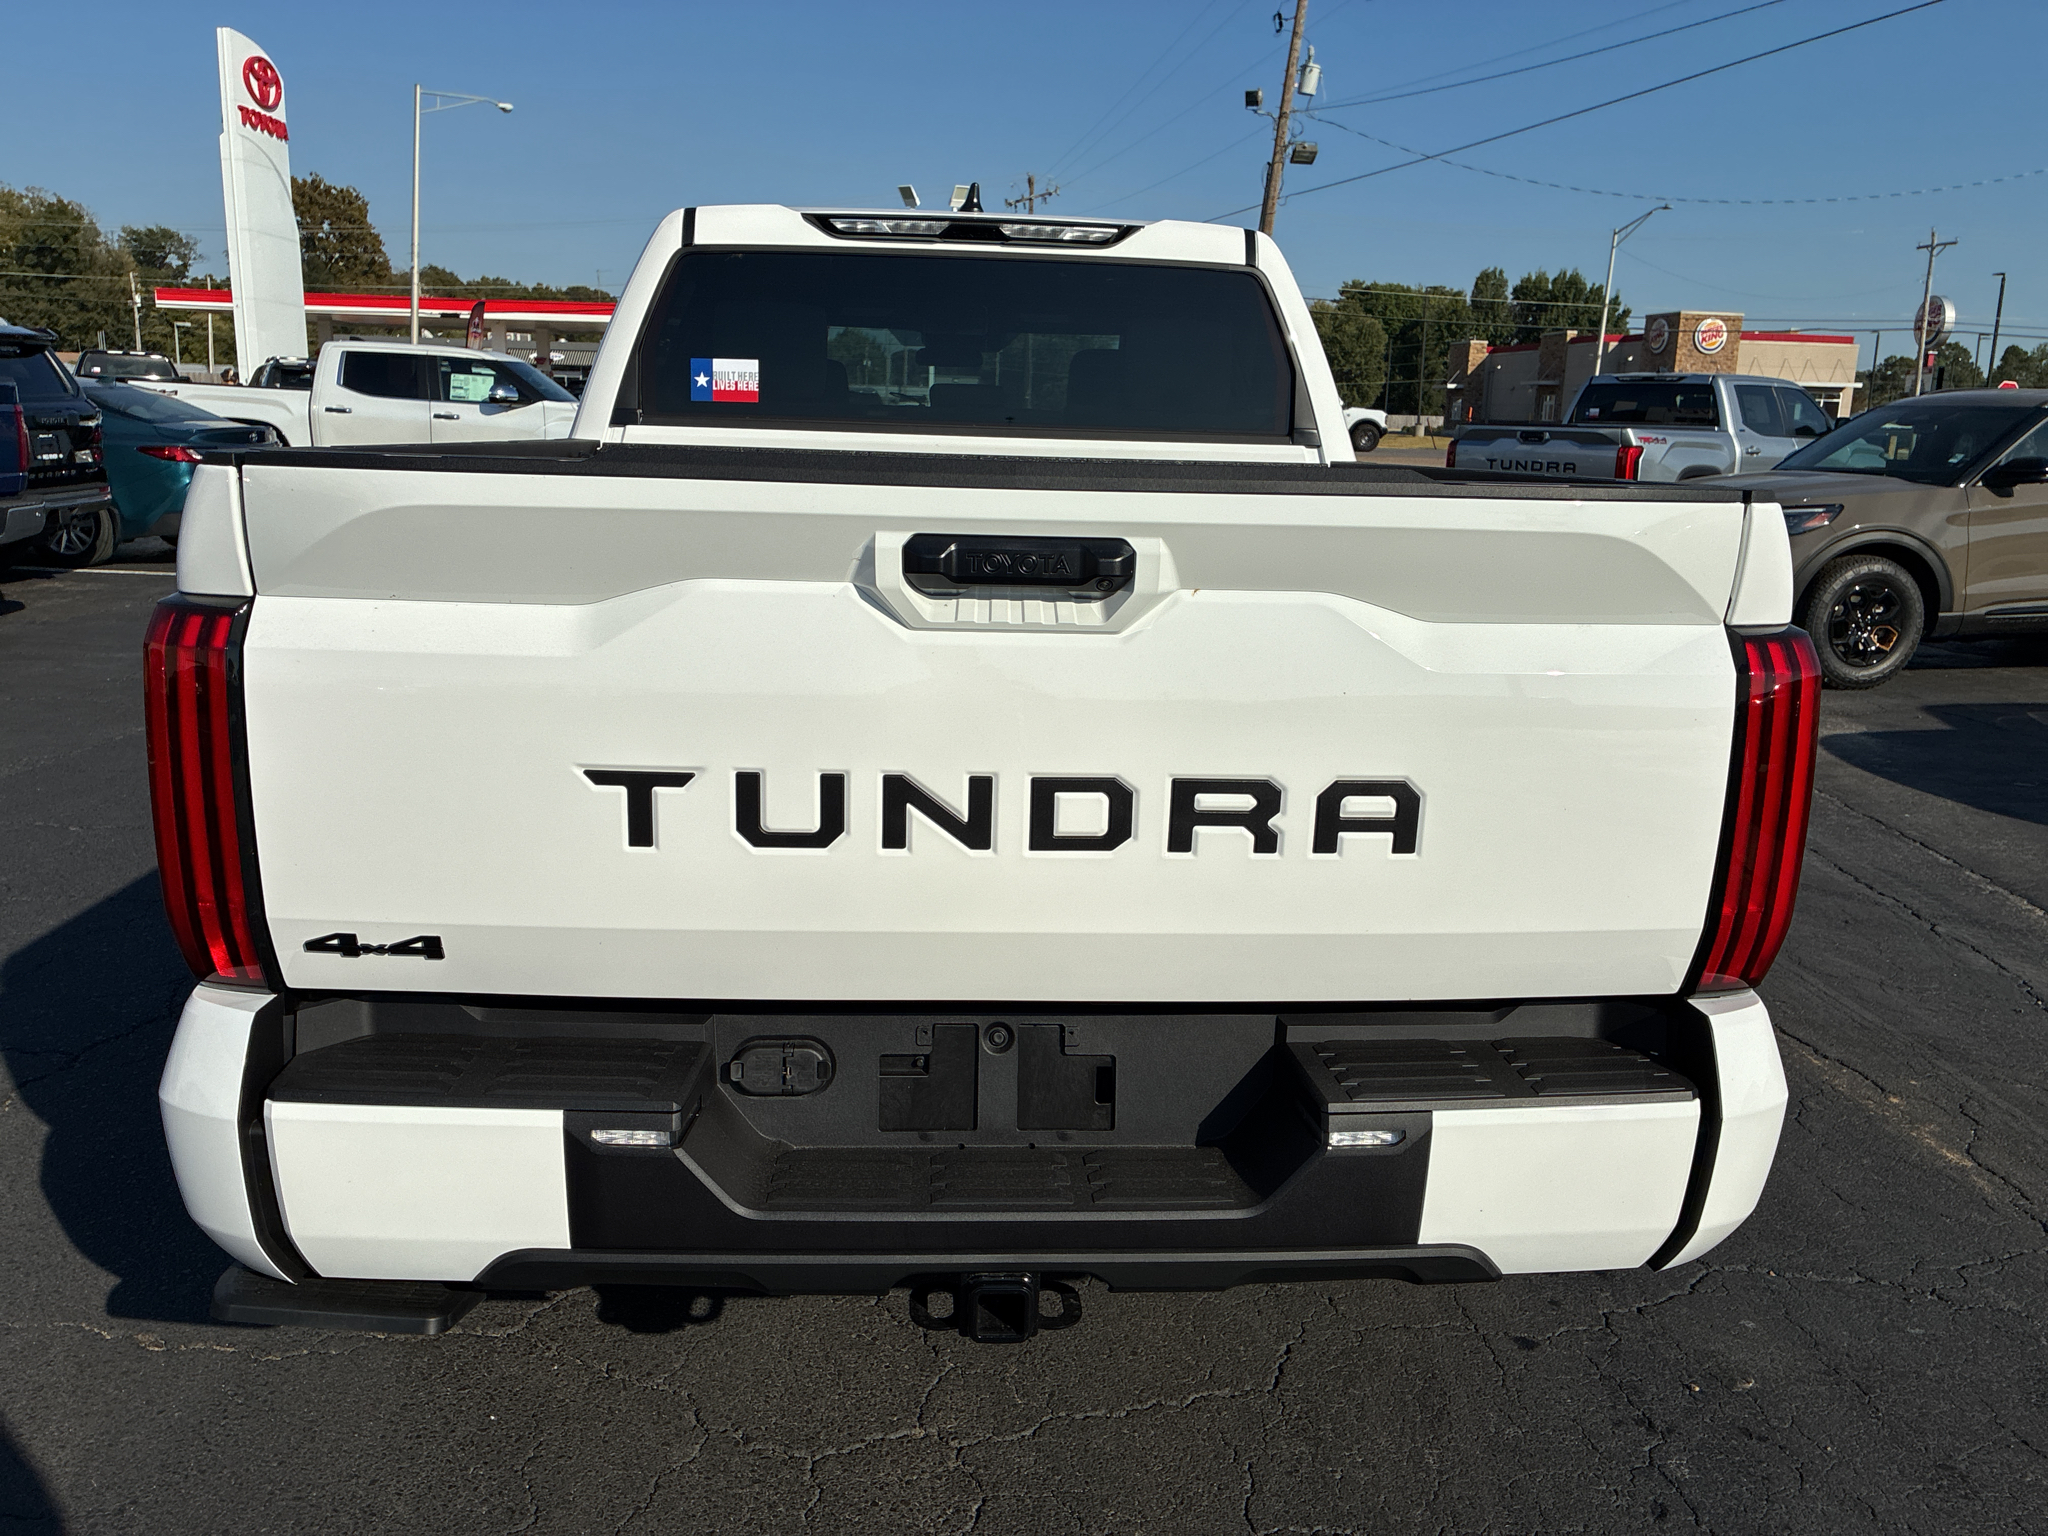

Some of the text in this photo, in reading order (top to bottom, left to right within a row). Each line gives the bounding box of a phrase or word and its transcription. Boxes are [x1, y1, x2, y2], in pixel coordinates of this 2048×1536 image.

[237, 104, 289, 143] TOYOTA
[1701, 332, 1723, 344] KING
[713, 371, 758, 381] BUILT HERE
[713, 380, 759, 391] LIVES HERE
[1487, 458, 1576, 473] TUNDRA
[966, 552, 1072, 575] TOYOTA
[577, 768, 1424, 857] TUNDRA
